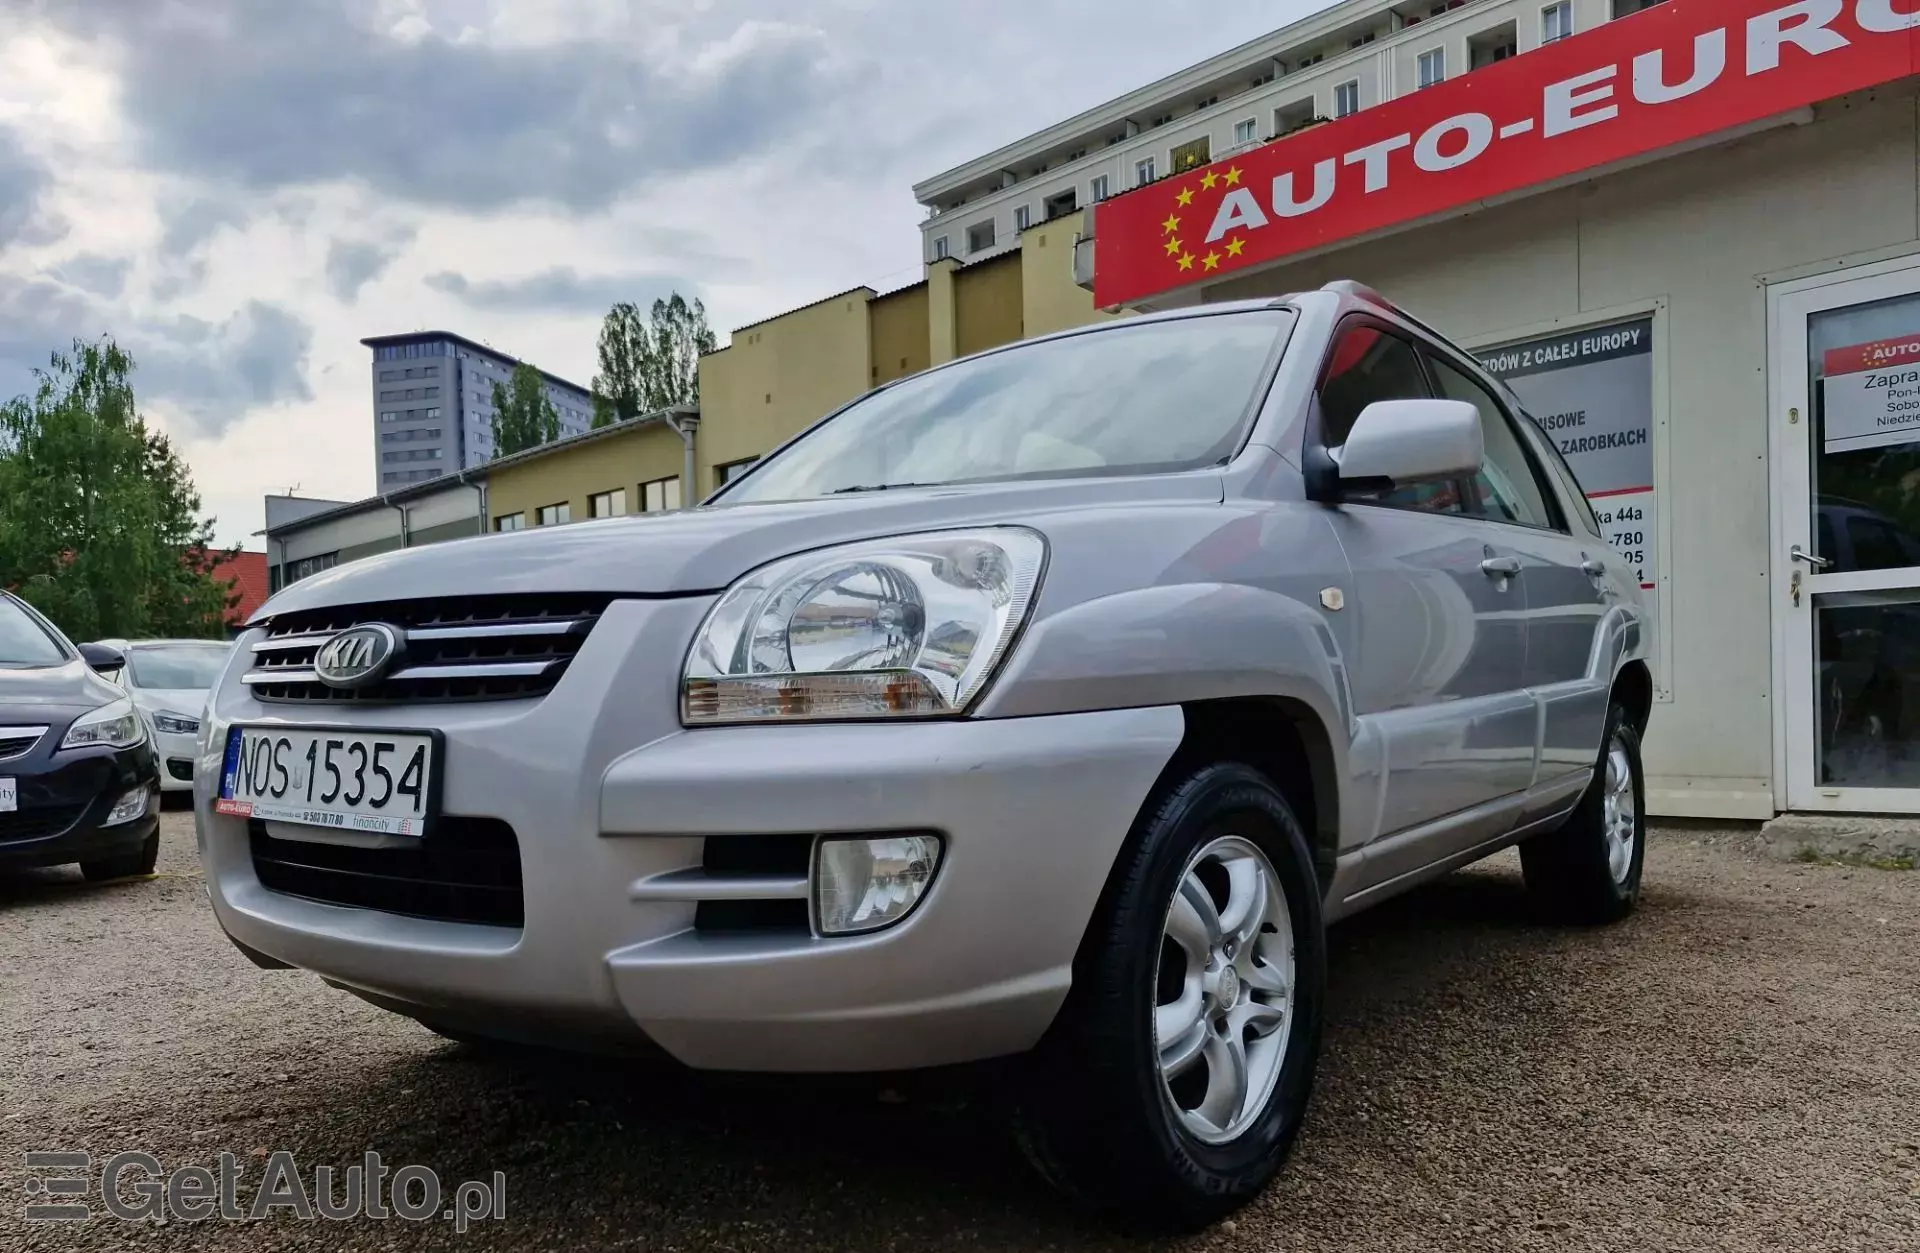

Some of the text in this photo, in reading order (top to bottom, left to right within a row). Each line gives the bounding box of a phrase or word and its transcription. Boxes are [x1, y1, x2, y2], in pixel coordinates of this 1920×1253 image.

[1522, 351, 1532, 367] Z
[1534, 341, 1578, 365] CAŁEJ
[1582, 328, 1641, 356] EUROPY
[1561, 428, 1647, 455] ZAROBKACH
[1616, 507, 1643, 521] 44a
[323, 636, 377, 669] KIA
[235, 736, 426, 813] NOS 15354
